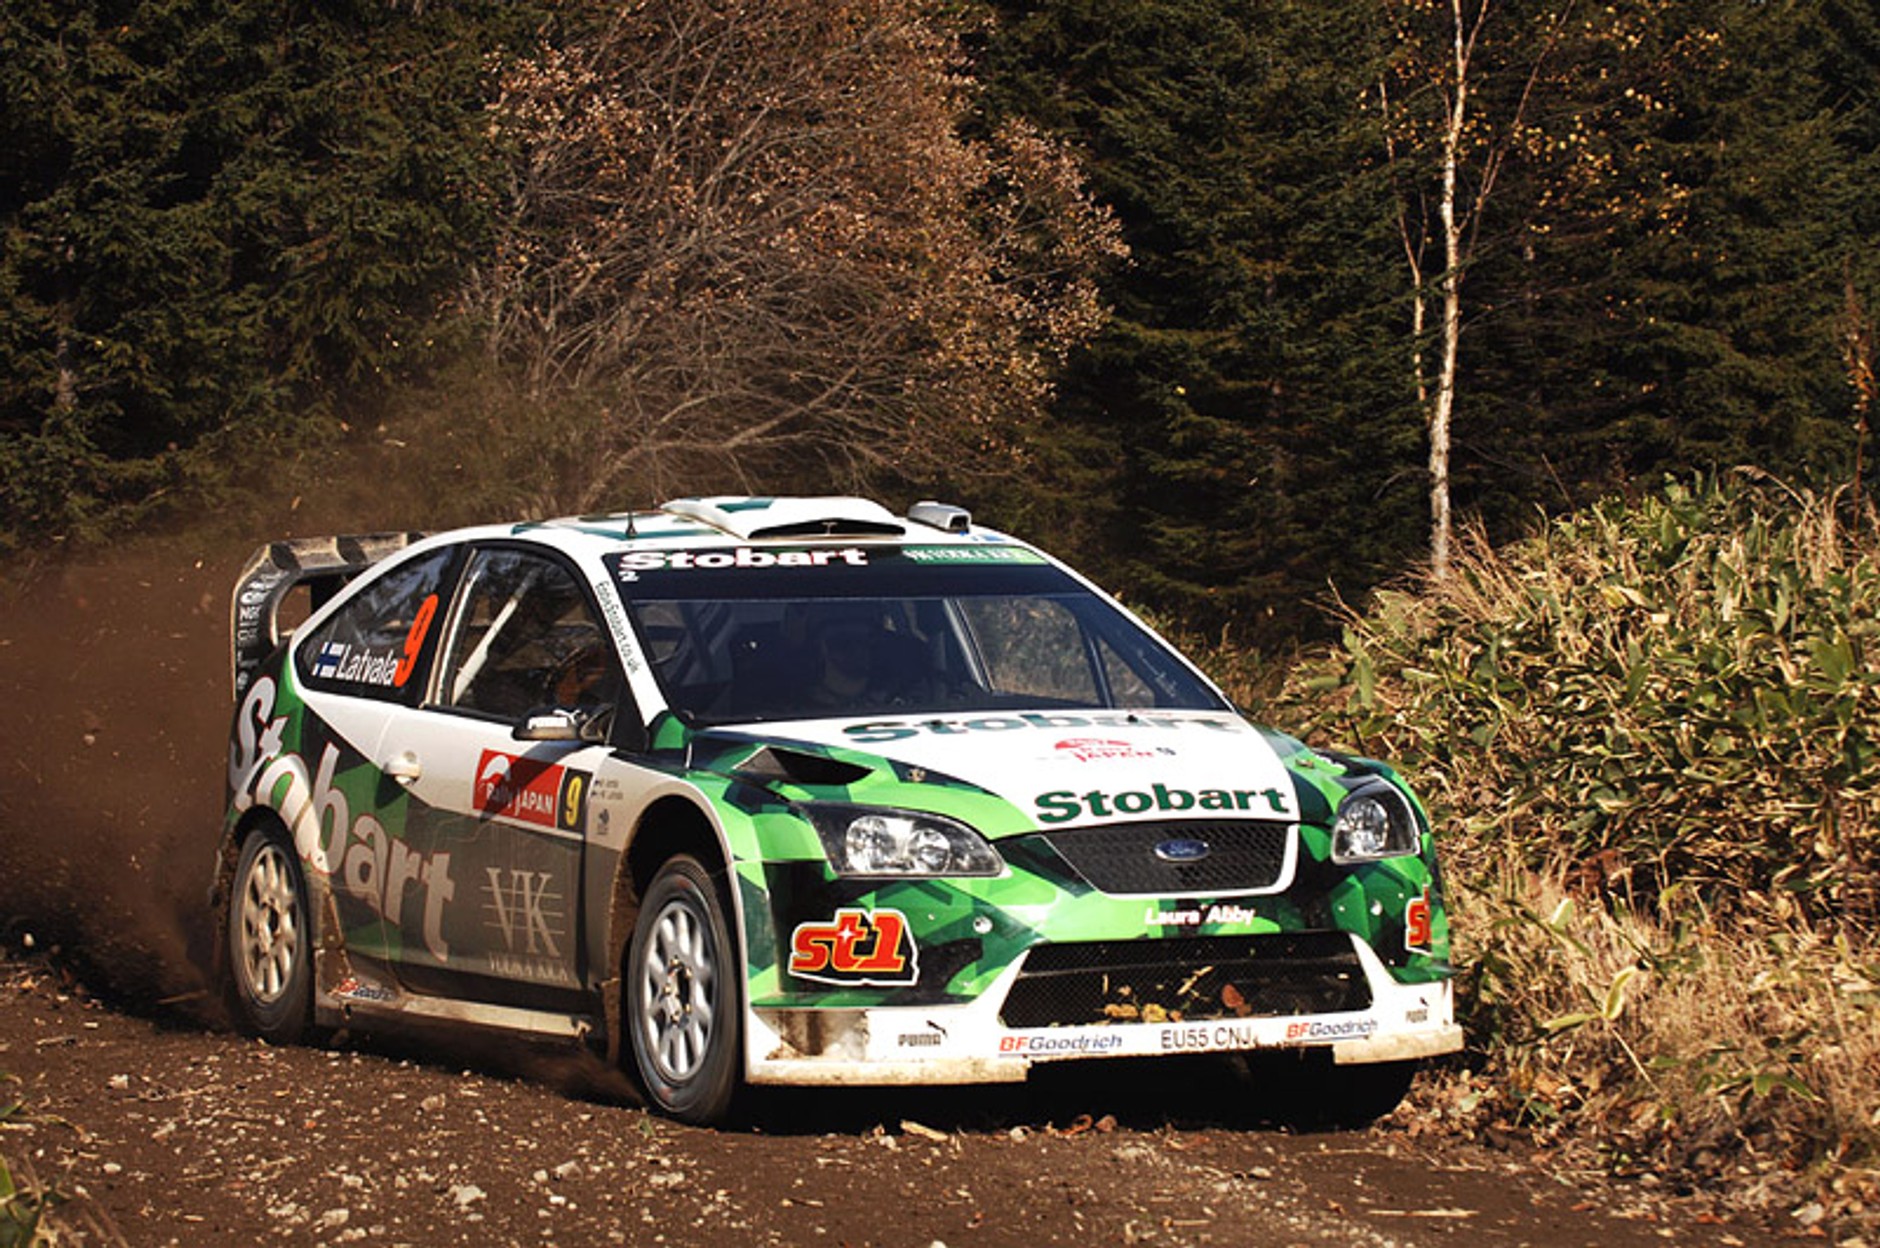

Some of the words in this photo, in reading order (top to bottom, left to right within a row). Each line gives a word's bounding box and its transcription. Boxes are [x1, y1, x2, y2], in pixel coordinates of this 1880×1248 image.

[619, 547, 868, 569] Stobart
[620, 570, 640, 582] 2
[393, 593, 439, 687] 9
[336, 644, 399, 686] Latvala
[843, 713, 1242, 744] Stobart
[565, 775, 583, 826] 9
[1035, 783, 1290, 824] Stobart
[229, 676, 455, 962] Stobart
[485, 866, 561, 958] VK
[1144, 907, 1201, 926] Laura
[1205, 904, 1256, 926] Abby
[898, 1033, 942, 1047] PUMA
[1160, 1028, 1210, 1049] EU55
[1286, 1018, 1378, 1039] BFGoodrich
[999, 1033, 1123, 1052] BFGoodrich
